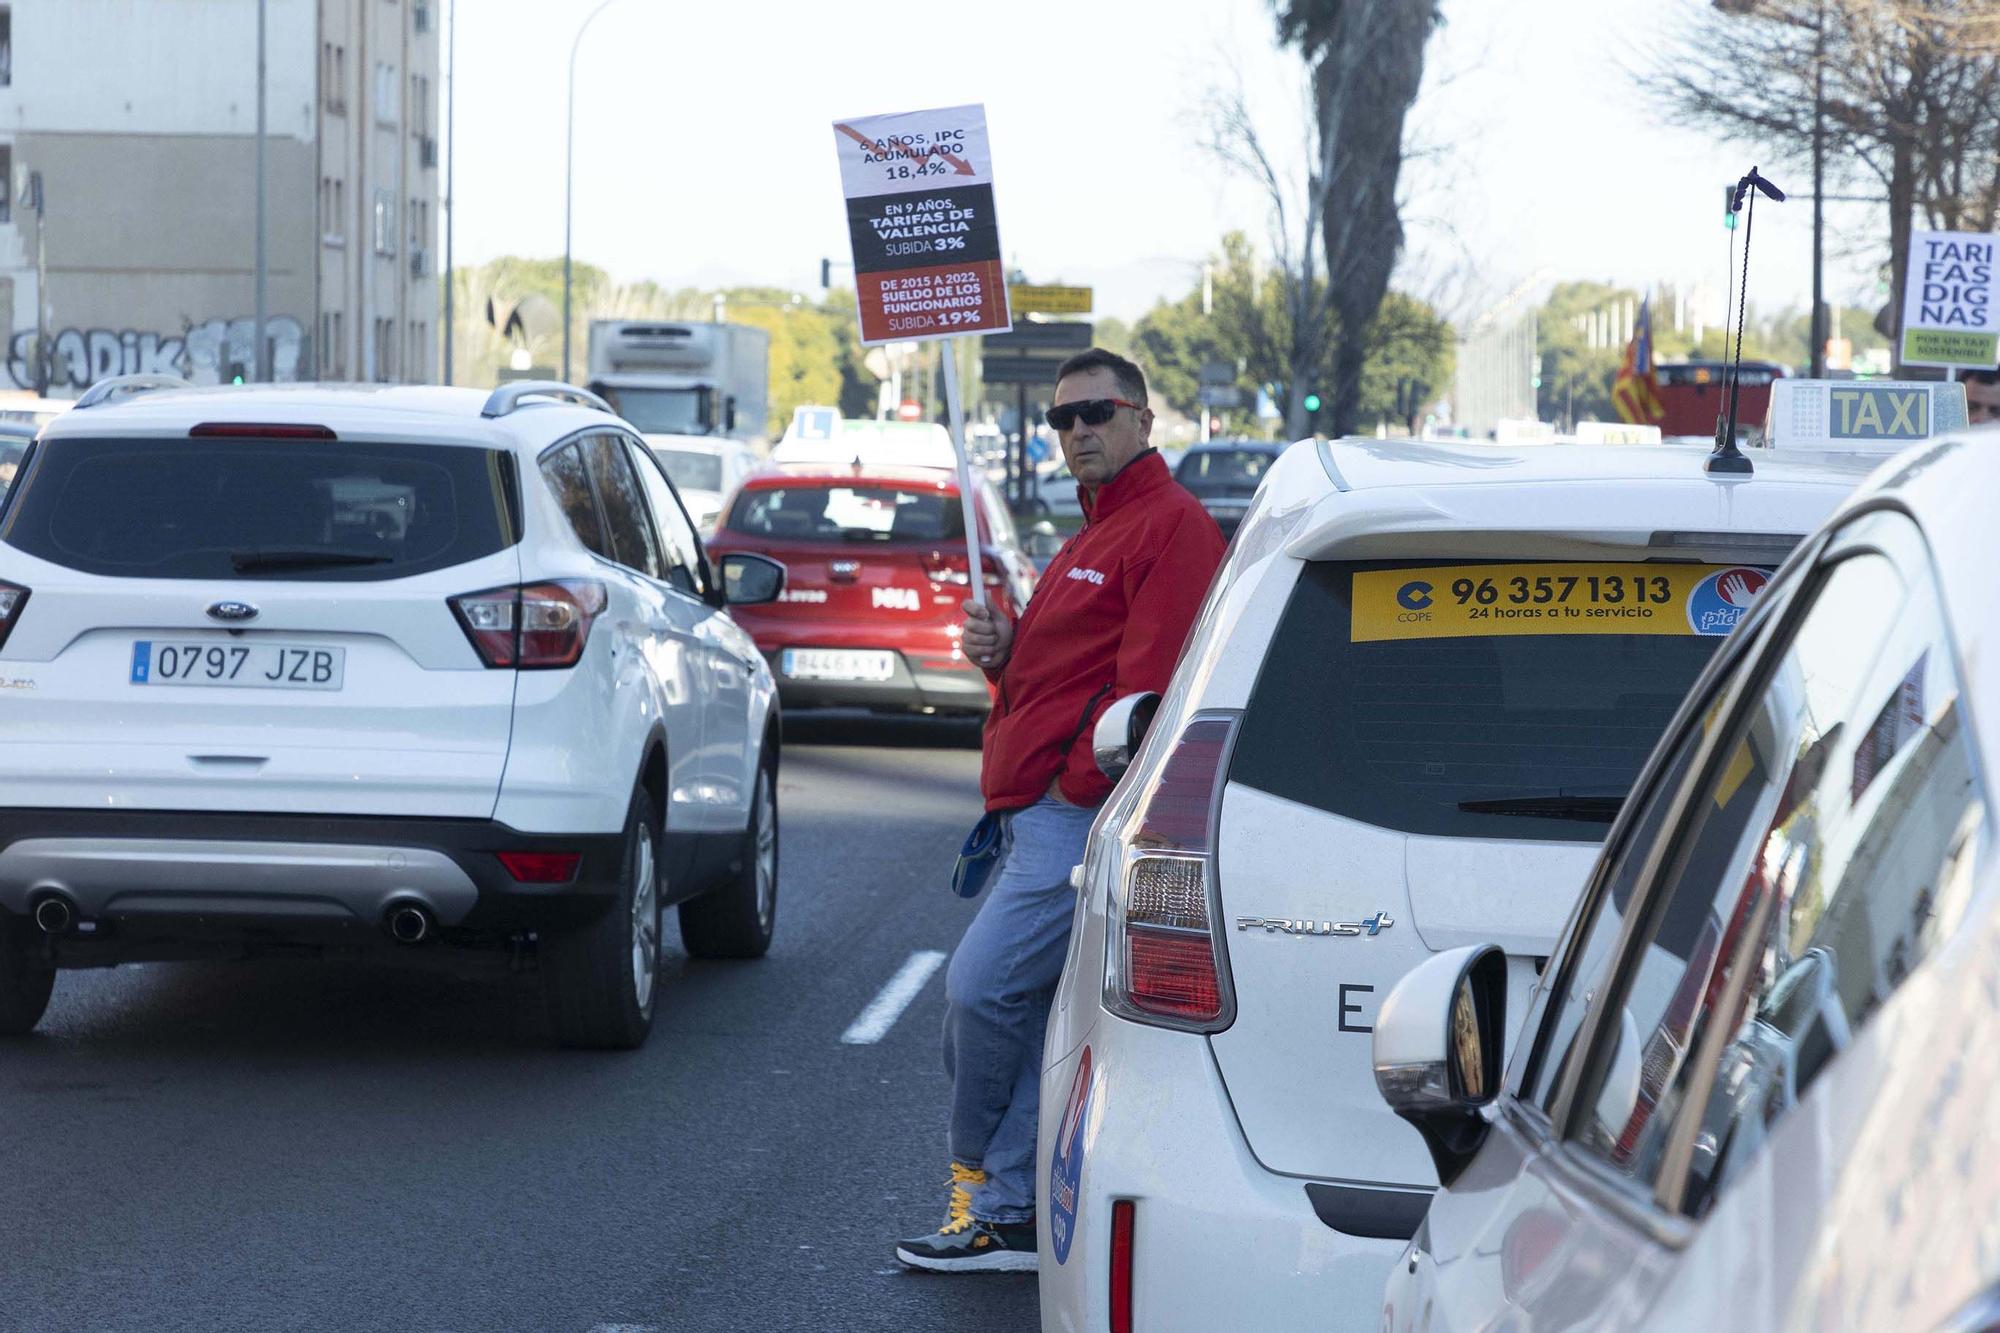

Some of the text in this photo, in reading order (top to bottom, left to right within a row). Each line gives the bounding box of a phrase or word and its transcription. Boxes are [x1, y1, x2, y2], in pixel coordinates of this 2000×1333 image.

[859, 129, 965, 151] 6 AÑOS, IPC
[864, 143, 964, 164] ACUMULADO
[887, 161, 946, 180] 18,4%
[885, 199, 956, 216] EN 9 AÑOS,
[870, 208, 974, 229] TARIFAS DE
[877, 222, 970, 240] VALENCIA
[886, 236, 966, 256] SUBIDA 3%
[1926, 241, 1992, 262] TARI
[880, 280, 898, 291] DE
[901, 277, 931, 289] 2015
[934, 275, 942, 286] A
[1925, 263, 1991, 284] FAS
[882, 283, 981, 303] SUELDO DE LOS
[1923, 284, 1988, 305] DIG
[883, 296, 982, 314] FUNCIONARIOS
[1920, 305, 1987, 326] NAS
[889, 310, 981, 331] SUBIDA 19%
[1832, 391, 1928, 436] TAXI
[1452, 577, 1498, 605] 96
[1508, 576, 1580, 604] 357
[1397, 612, 1432, 622] COPE
[1469, 604, 1653, 619] 24 horas a tu servicio
[1702, 608, 1745, 630] pid
[158, 646, 332, 682] 0797 JZB
